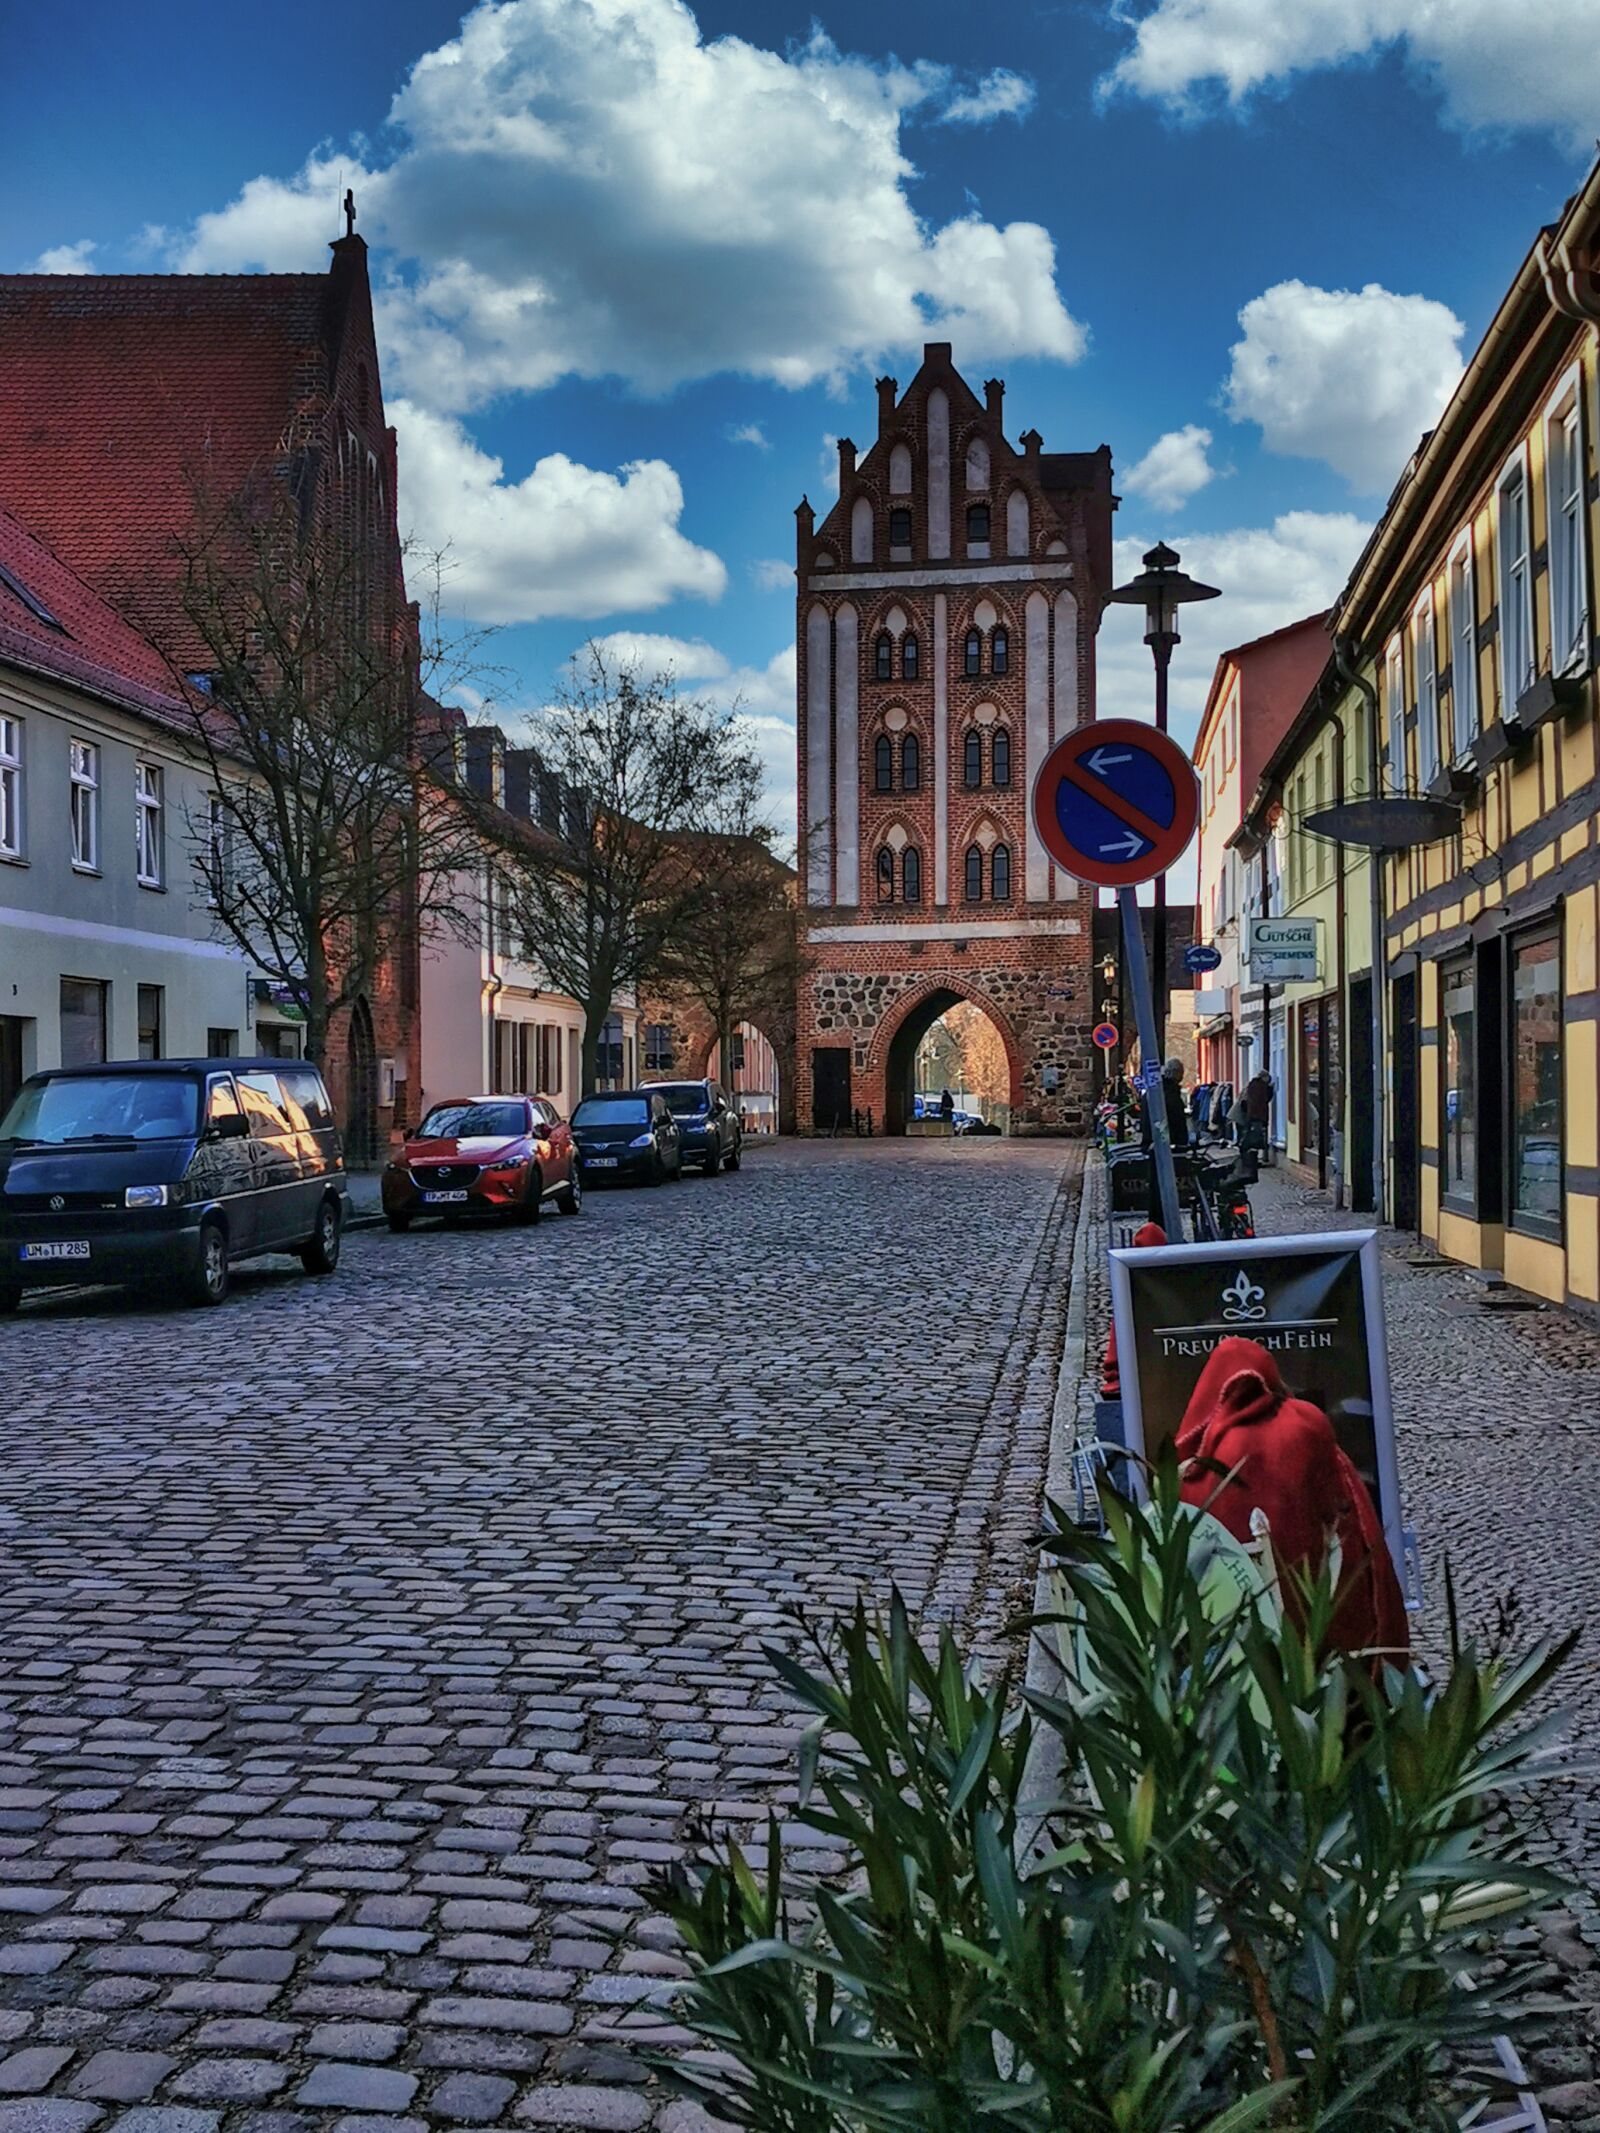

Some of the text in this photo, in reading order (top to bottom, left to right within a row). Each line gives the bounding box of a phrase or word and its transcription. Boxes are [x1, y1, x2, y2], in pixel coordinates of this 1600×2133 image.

[1273, 951, 1314, 960] SIEMENS
[27, 1242, 89, 1256] UM TT 285
